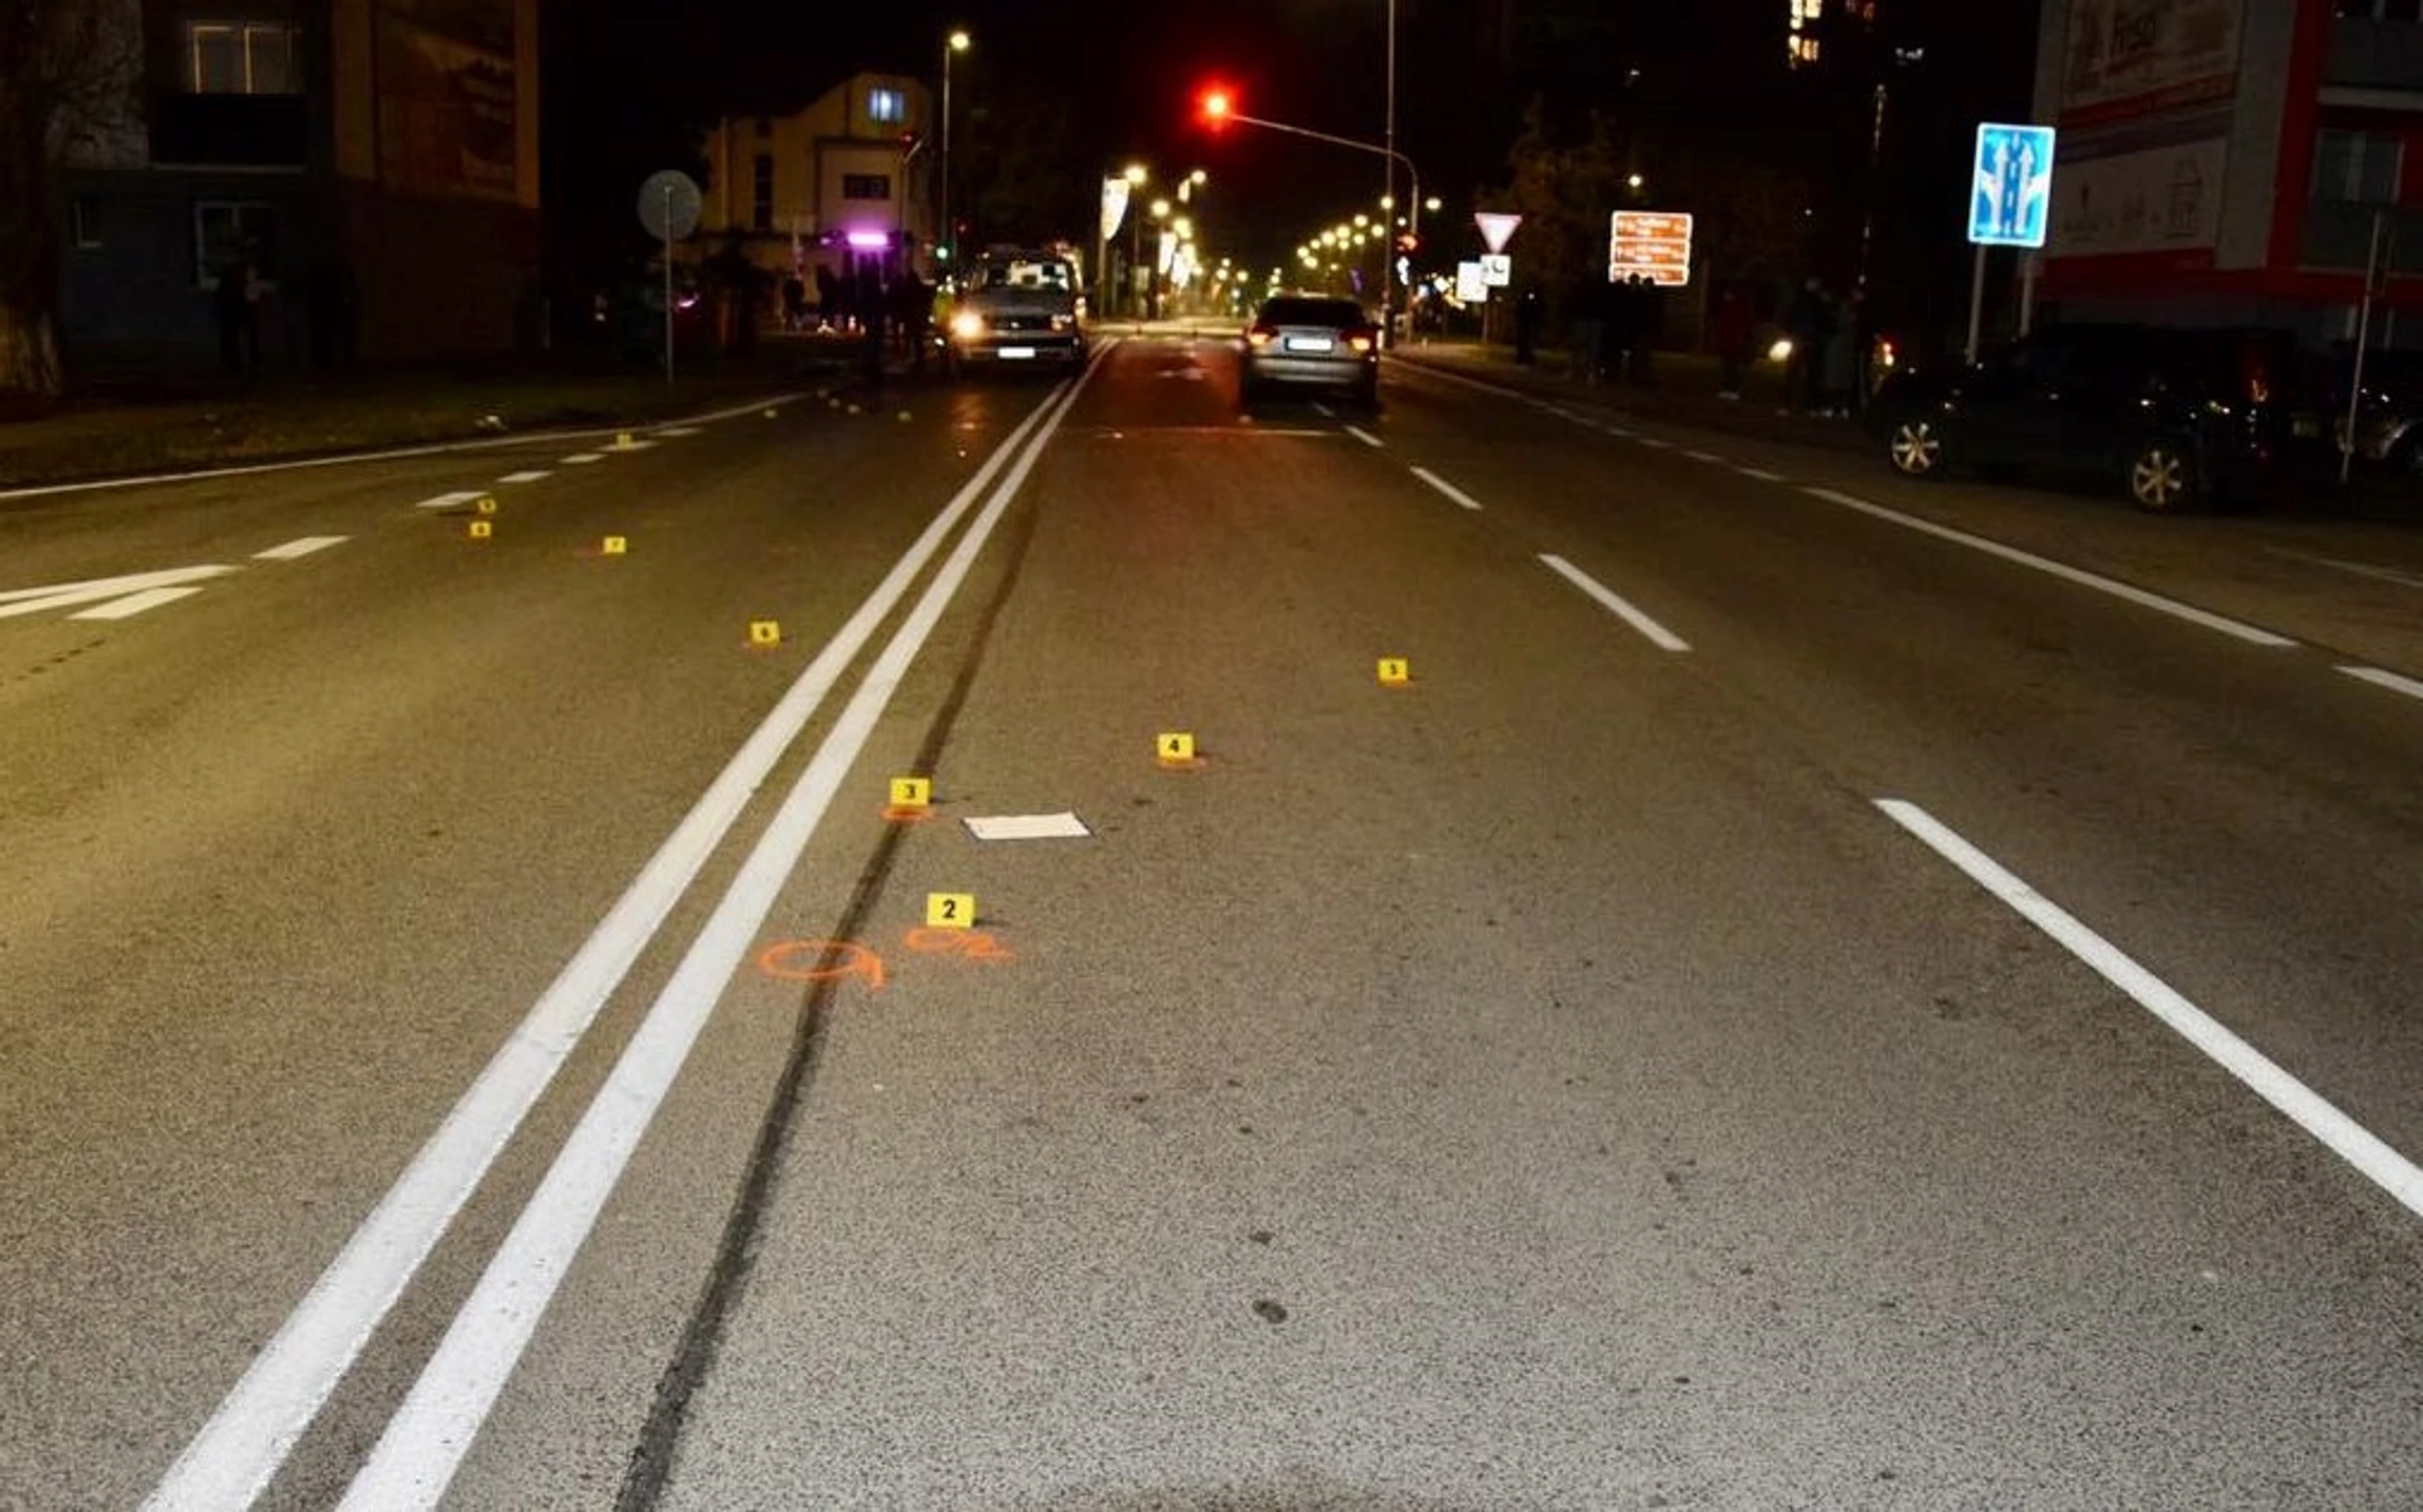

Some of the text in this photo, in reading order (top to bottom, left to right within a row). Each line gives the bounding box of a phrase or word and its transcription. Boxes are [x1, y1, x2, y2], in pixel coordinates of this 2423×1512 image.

[1168, 739, 1179, 753] 4
[905, 784, 915, 799] 3
[942, 899, 956, 919] 2
